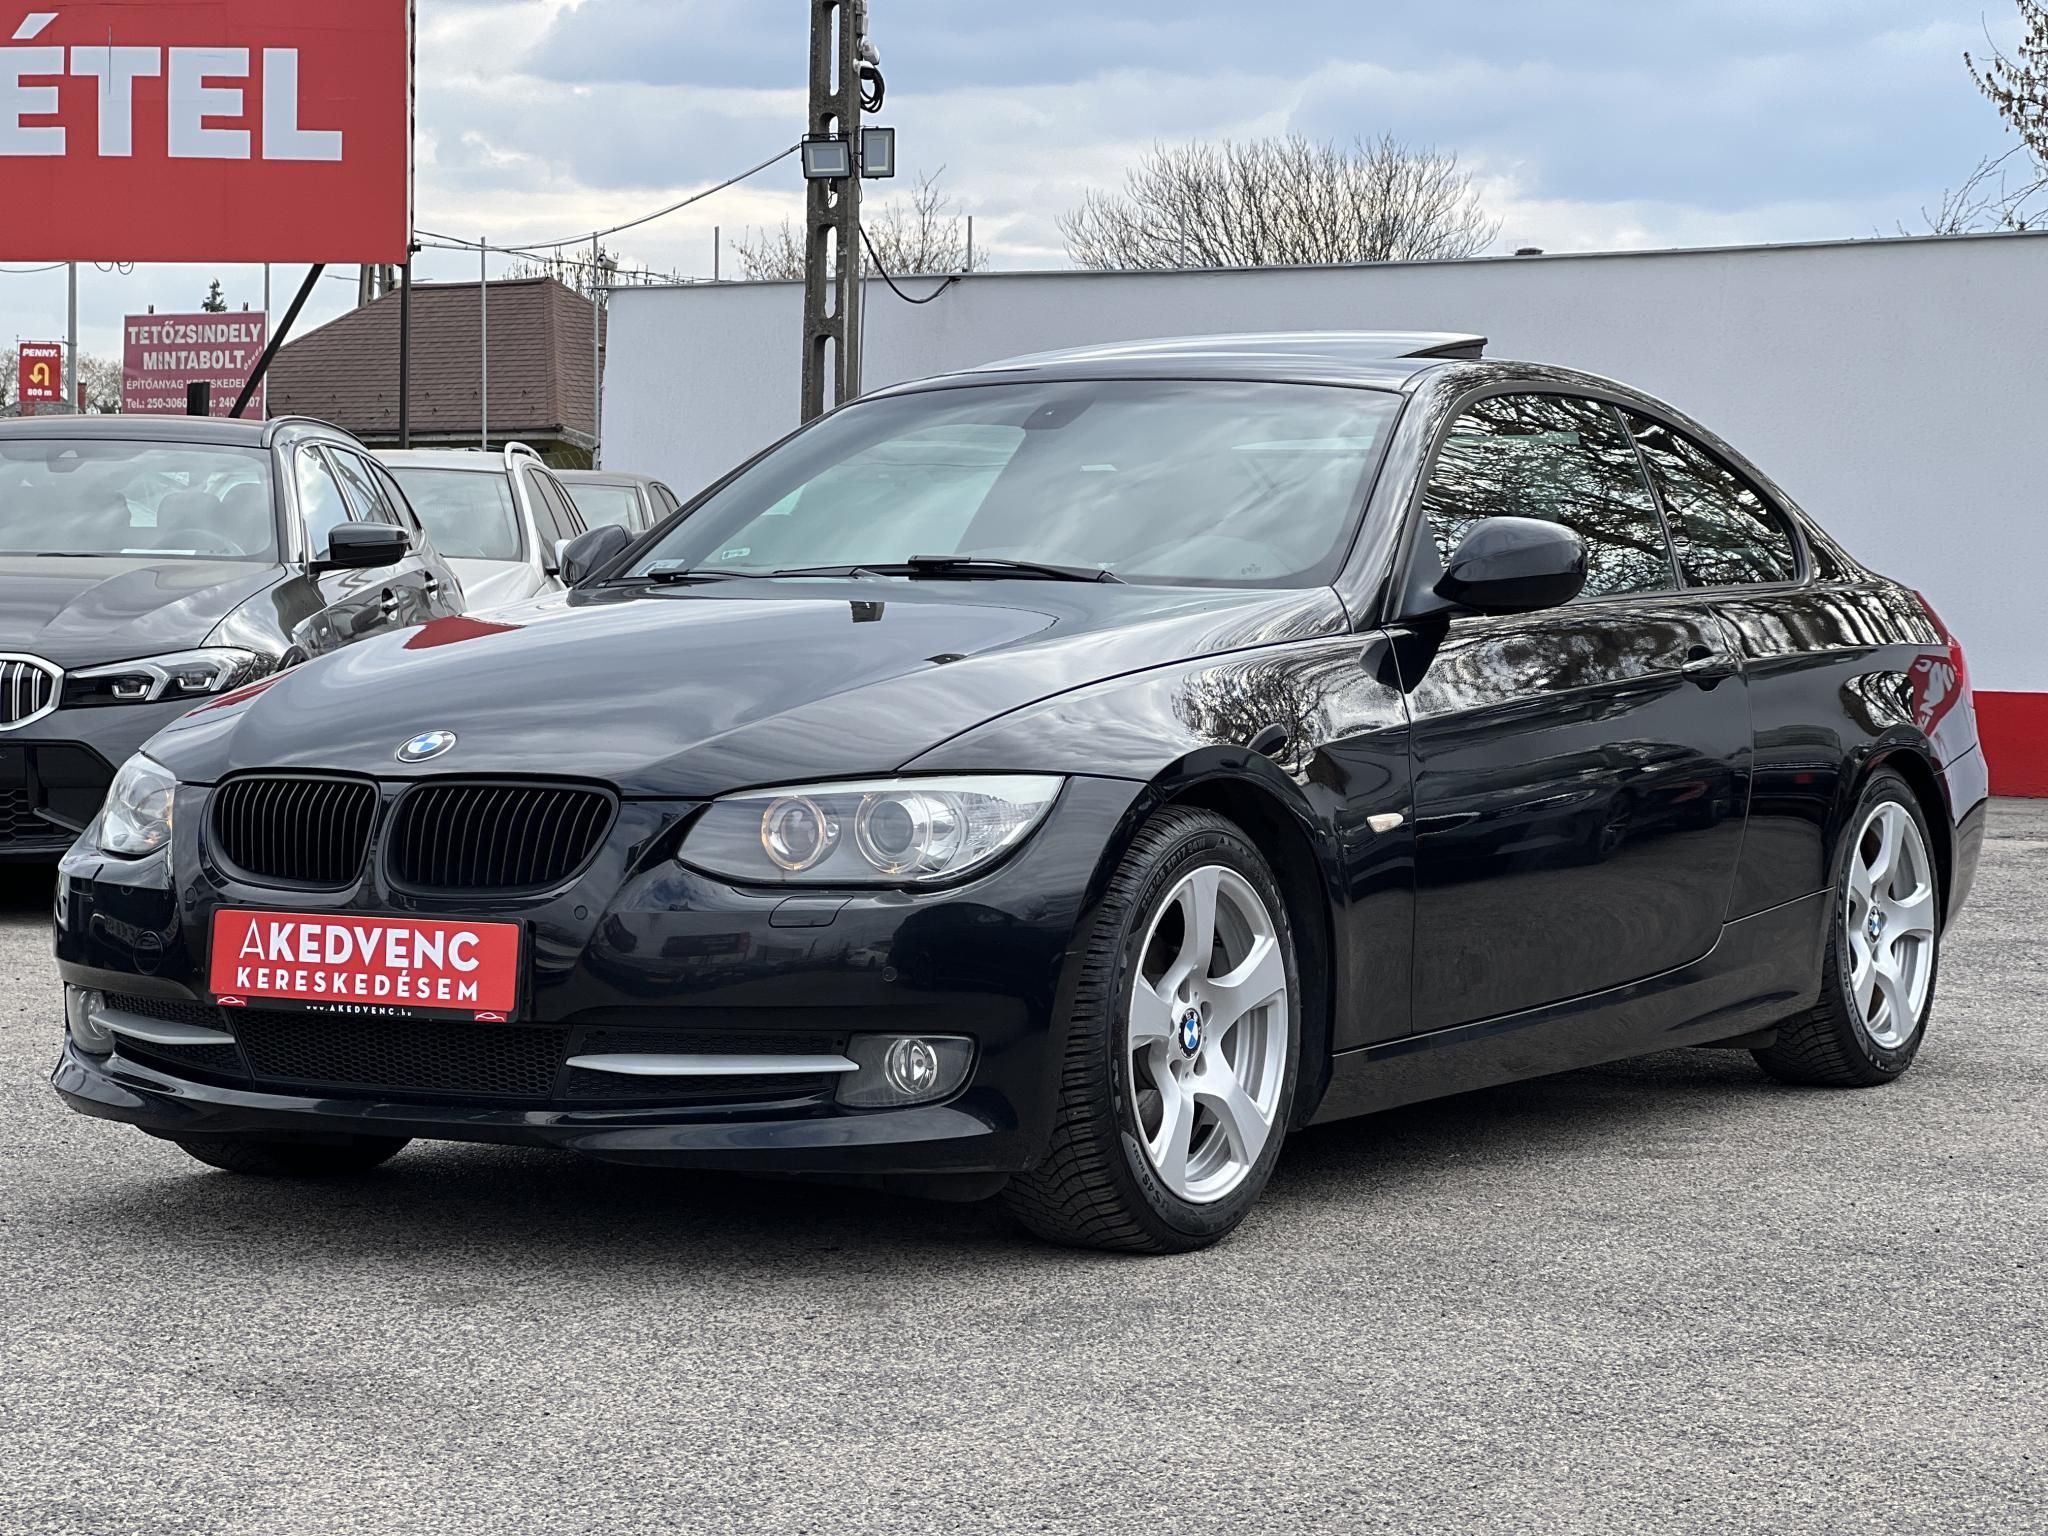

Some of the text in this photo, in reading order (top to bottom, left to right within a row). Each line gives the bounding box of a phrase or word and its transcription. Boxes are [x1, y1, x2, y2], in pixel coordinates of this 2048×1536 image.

[0, 13, 342, 161] ÉTEL
[128, 320, 262, 345] TETŐZSINDELY
[143, 350, 245, 370] MINTABOLT
[27, 388, 43, 396] 800
[126, 378, 184, 390] ÉPÍTŐANYAG
[125, 397, 145, 409] Tel.:
[236, 966, 478, 1002] KERESKEDÉSEM
